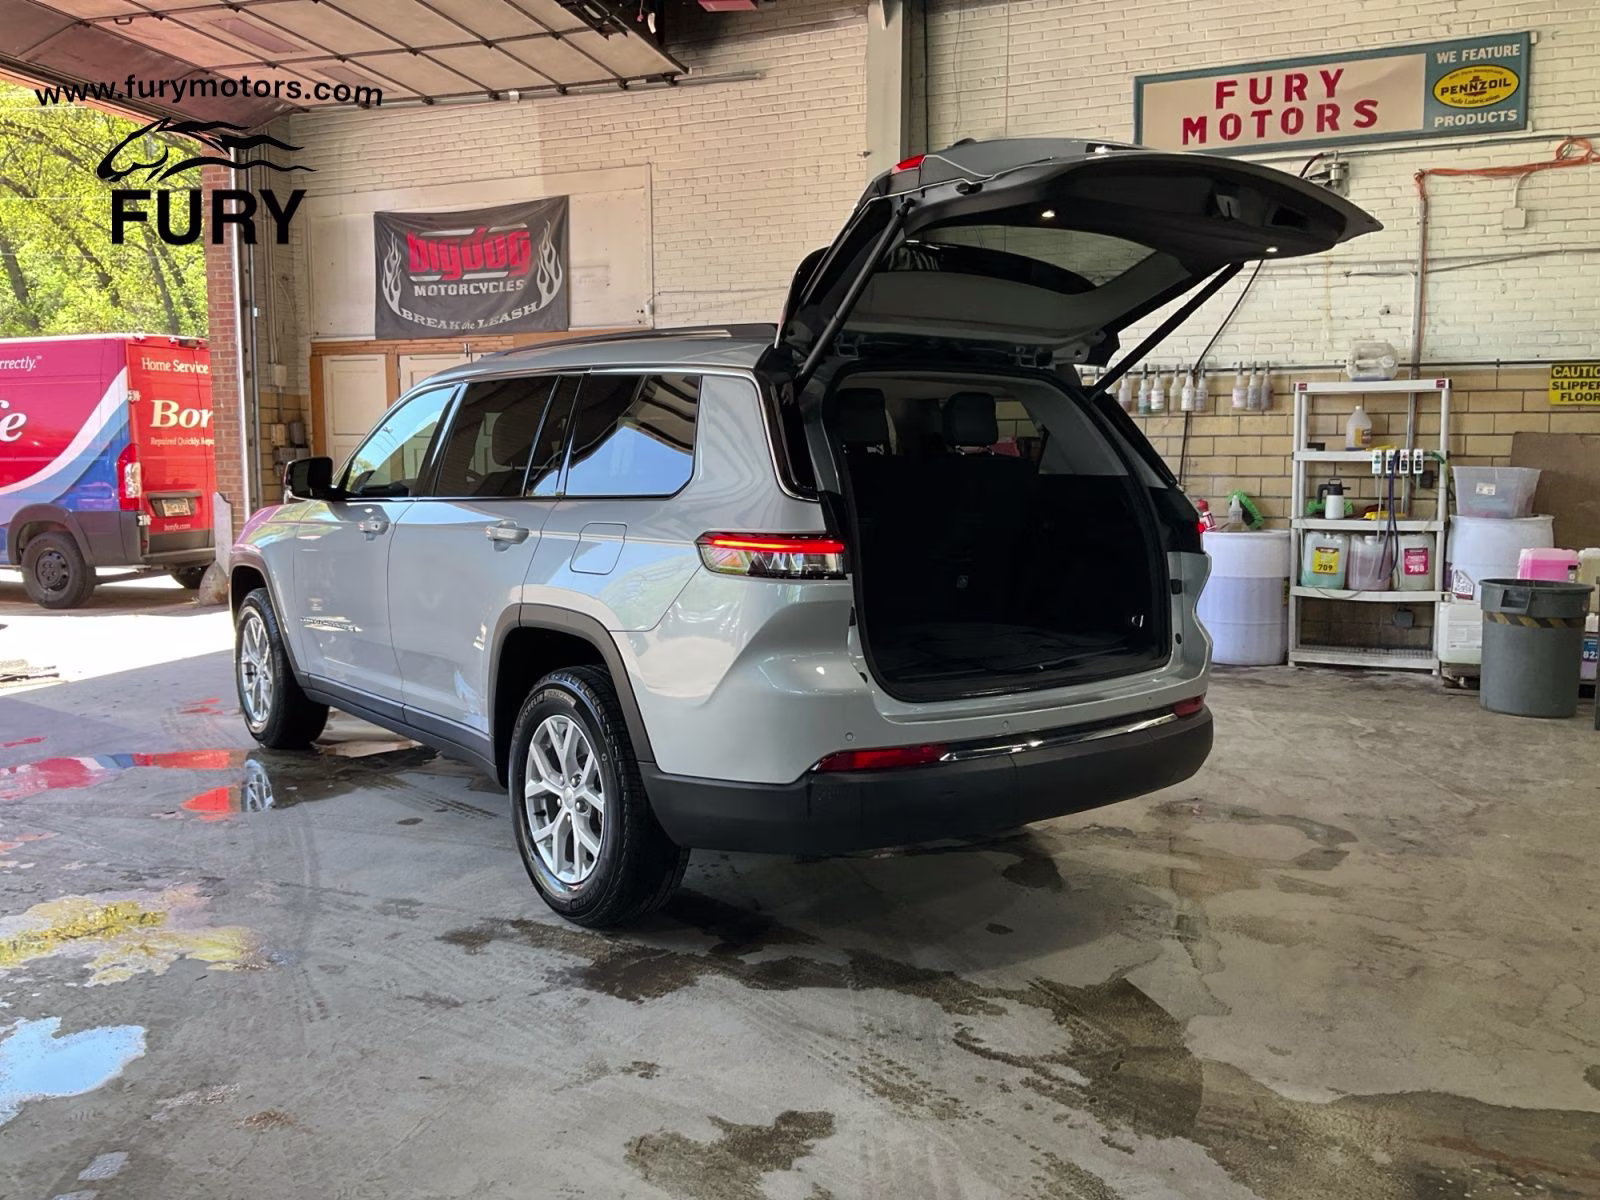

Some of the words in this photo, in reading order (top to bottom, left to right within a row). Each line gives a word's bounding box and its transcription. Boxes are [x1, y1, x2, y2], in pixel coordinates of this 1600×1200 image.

[1437, 51, 1457, 64] WE
[1462, 44, 1520, 61] FEATURE
[1215, 68, 1345, 109] FURY
[1440, 78, 1511, 96] PENNZOIL
[1182, 99, 1379, 146] MOTORS
[1434, 109, 1517, 127] PRODUCTS
[414, 279, 525, 297] MOTORCYCLES
[401, 308, 462, 330] BREAK
[461, 320, 475, 330] the
[477, 302, 538, 329] LEASH
[142, 357, 171, 372] Home
[173, 360, 209, 374] Service
[1318, 564, 1334, 572] 709
